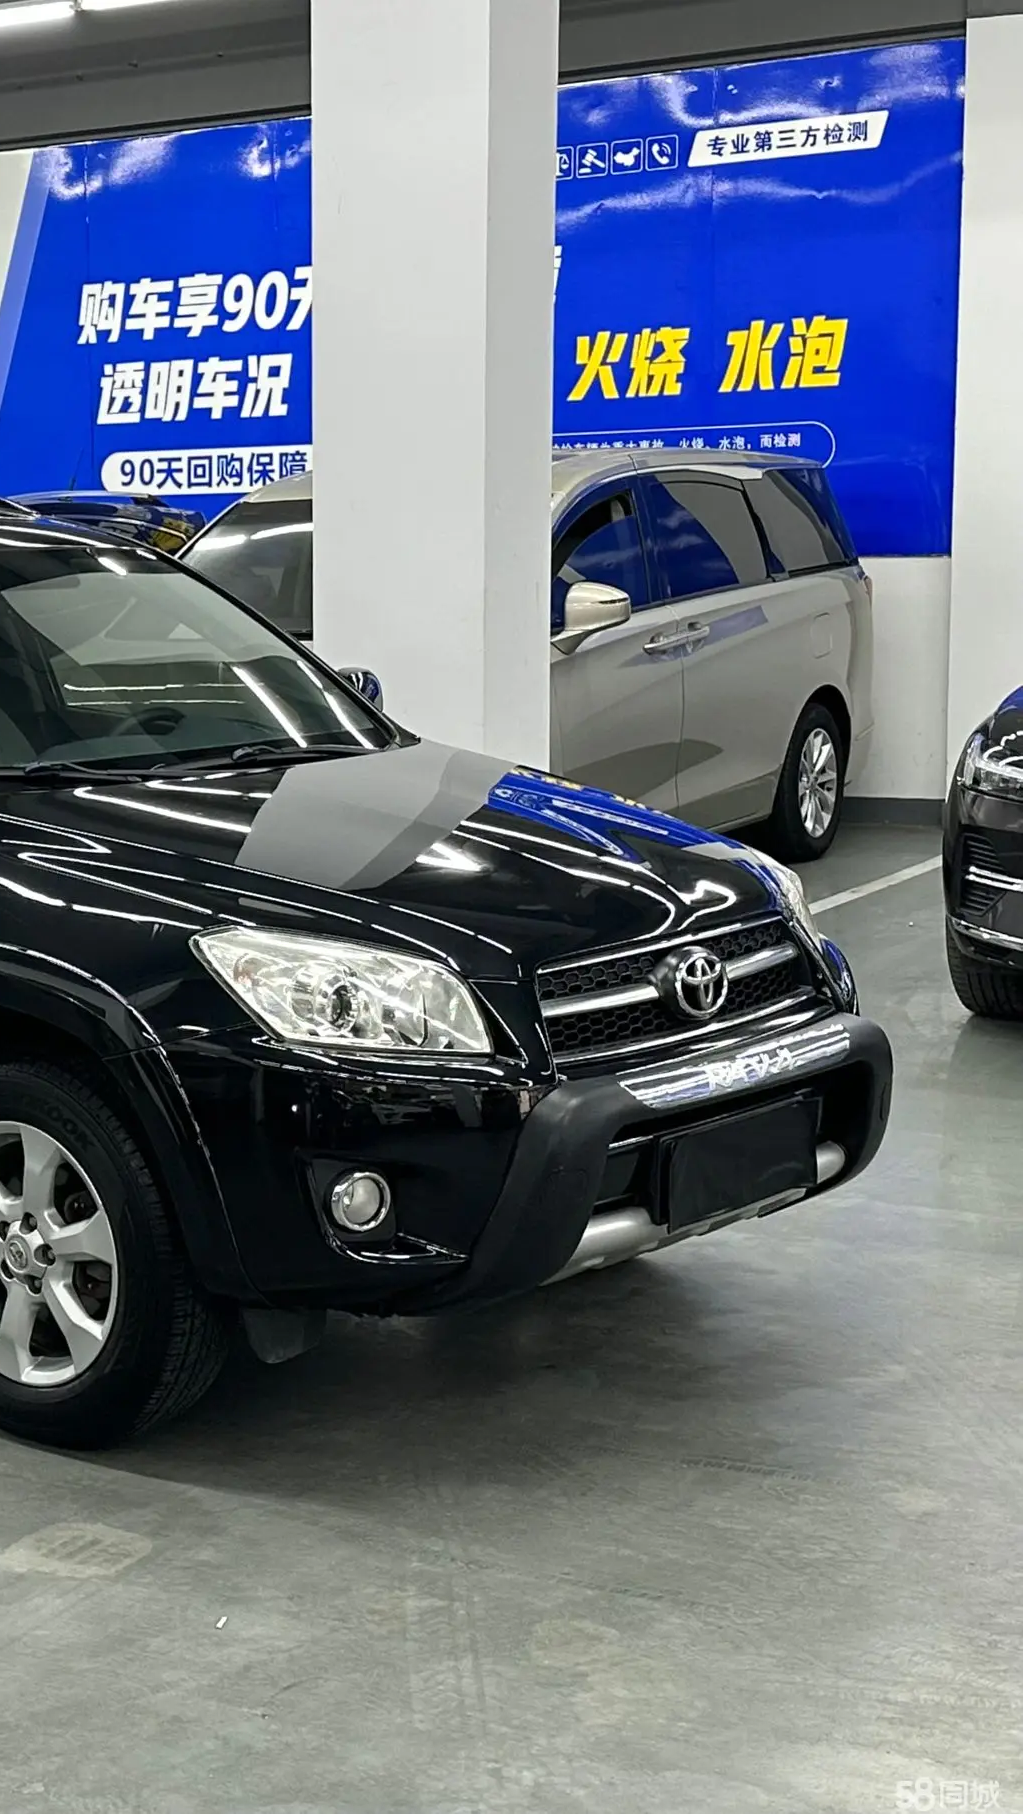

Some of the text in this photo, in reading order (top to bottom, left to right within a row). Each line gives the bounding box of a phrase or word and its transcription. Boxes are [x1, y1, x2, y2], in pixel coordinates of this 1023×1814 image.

[706, 119, 869, 157] 专业第三方检测
[96, 353, 293, 426] 透明车况
[566, 315, 849, 402] 火烧 水泡
